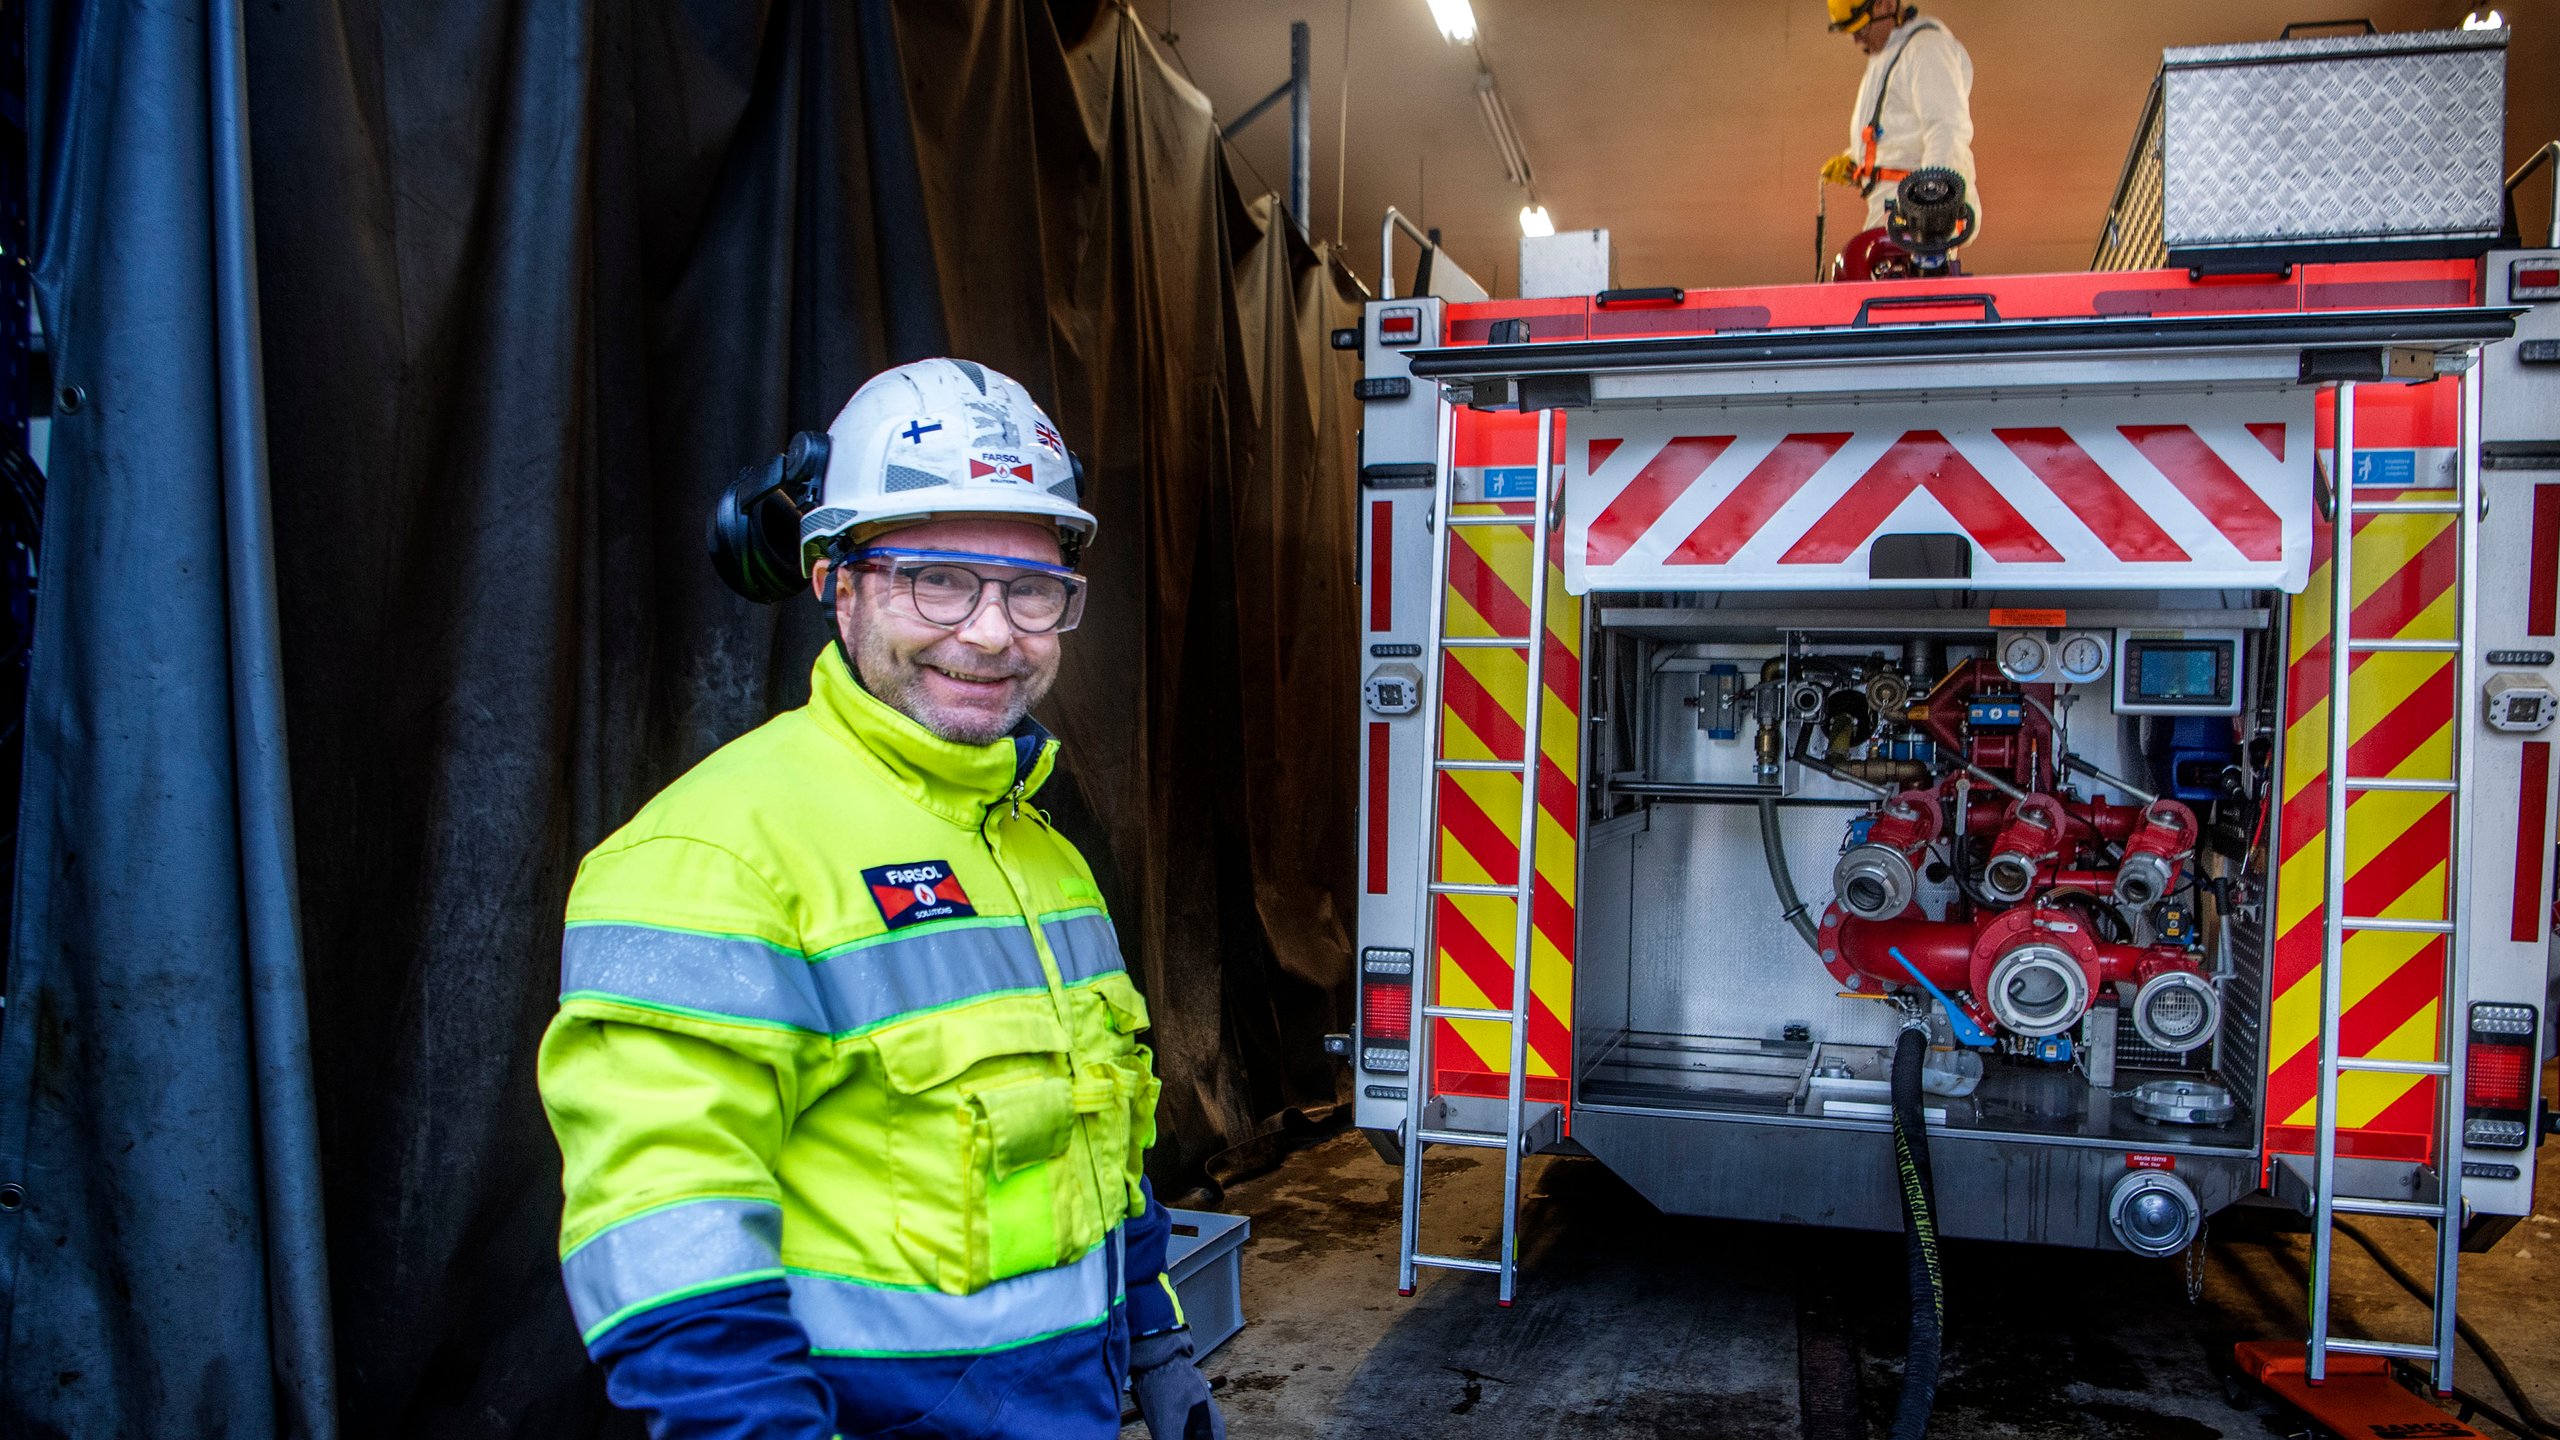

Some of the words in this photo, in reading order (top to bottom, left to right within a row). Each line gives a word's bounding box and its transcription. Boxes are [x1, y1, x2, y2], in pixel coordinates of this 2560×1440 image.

[982, 453, 1022, 464] FARSOL
[886, 866, 942, 885] FARSOL
[915, 906, 953, 919] SOLUTIONS
